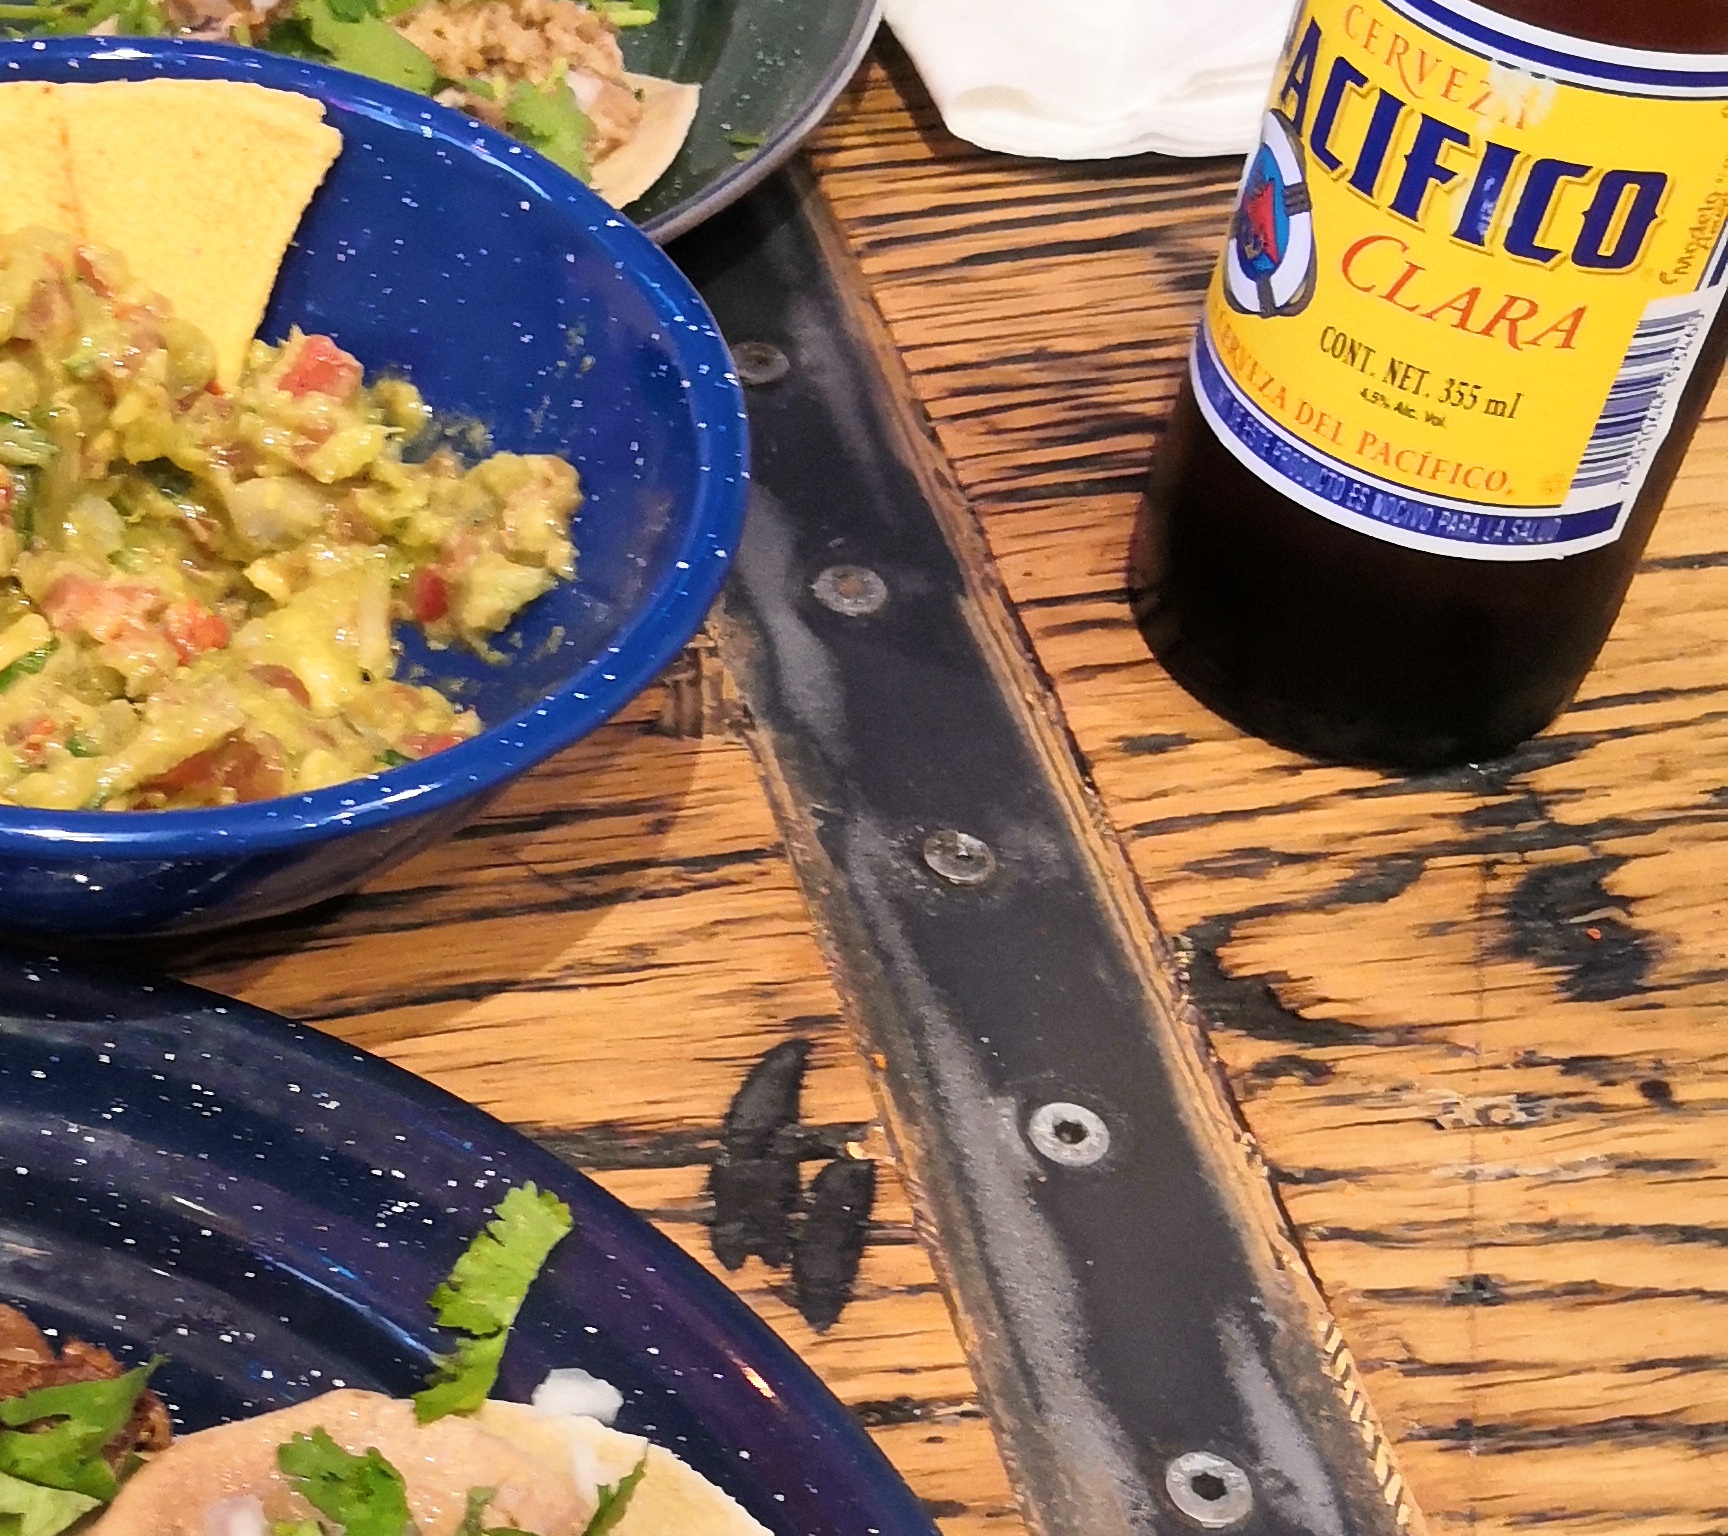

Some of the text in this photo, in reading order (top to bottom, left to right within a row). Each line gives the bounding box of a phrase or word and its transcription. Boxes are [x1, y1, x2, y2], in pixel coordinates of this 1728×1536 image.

[1344, 4, 1534, 130] CERVEZA
[1281, 16, 1668, 269] ACIFICO
[1342, 234, 1588, 351] CLARA
[1295, 401, 1343, 446] DEL
[1320, 325, 1524, 419] CONT. NET. 355 ml
